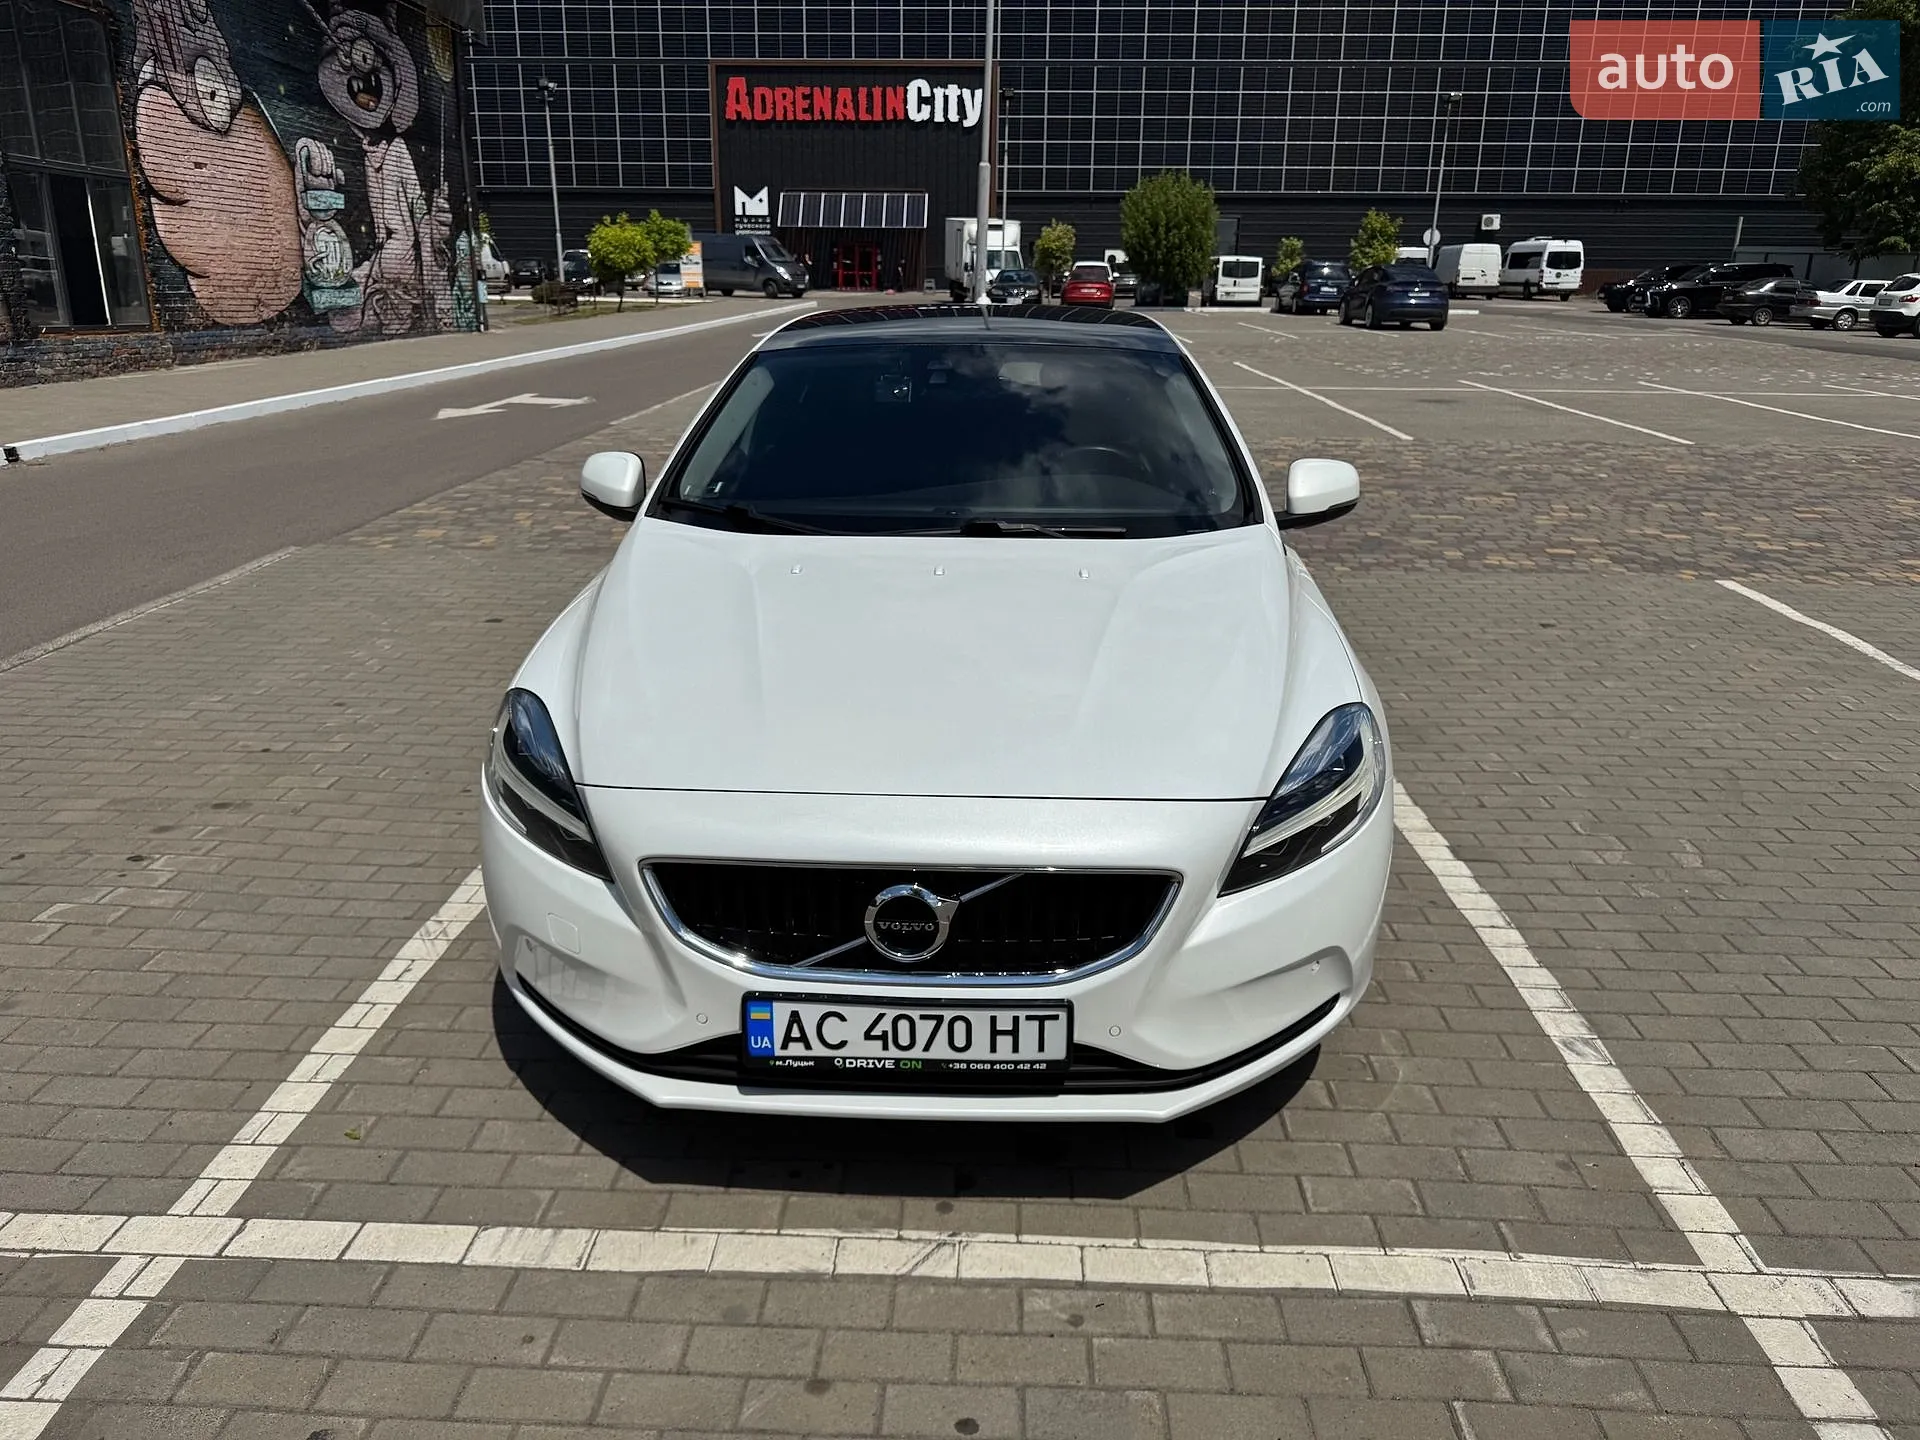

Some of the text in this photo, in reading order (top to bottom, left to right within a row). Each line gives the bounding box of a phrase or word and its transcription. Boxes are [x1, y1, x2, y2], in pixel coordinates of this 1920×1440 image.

[877, 921, 935, 932] VOLVO
[780, 1010, 1060, 1054] AC 4070 HT
[750, 1036, 772, 1049] UA
[845, 1058, 923, 1070] DRIVE ON
[948, 1062, 1047, 1071] +38 068 400 42 42
